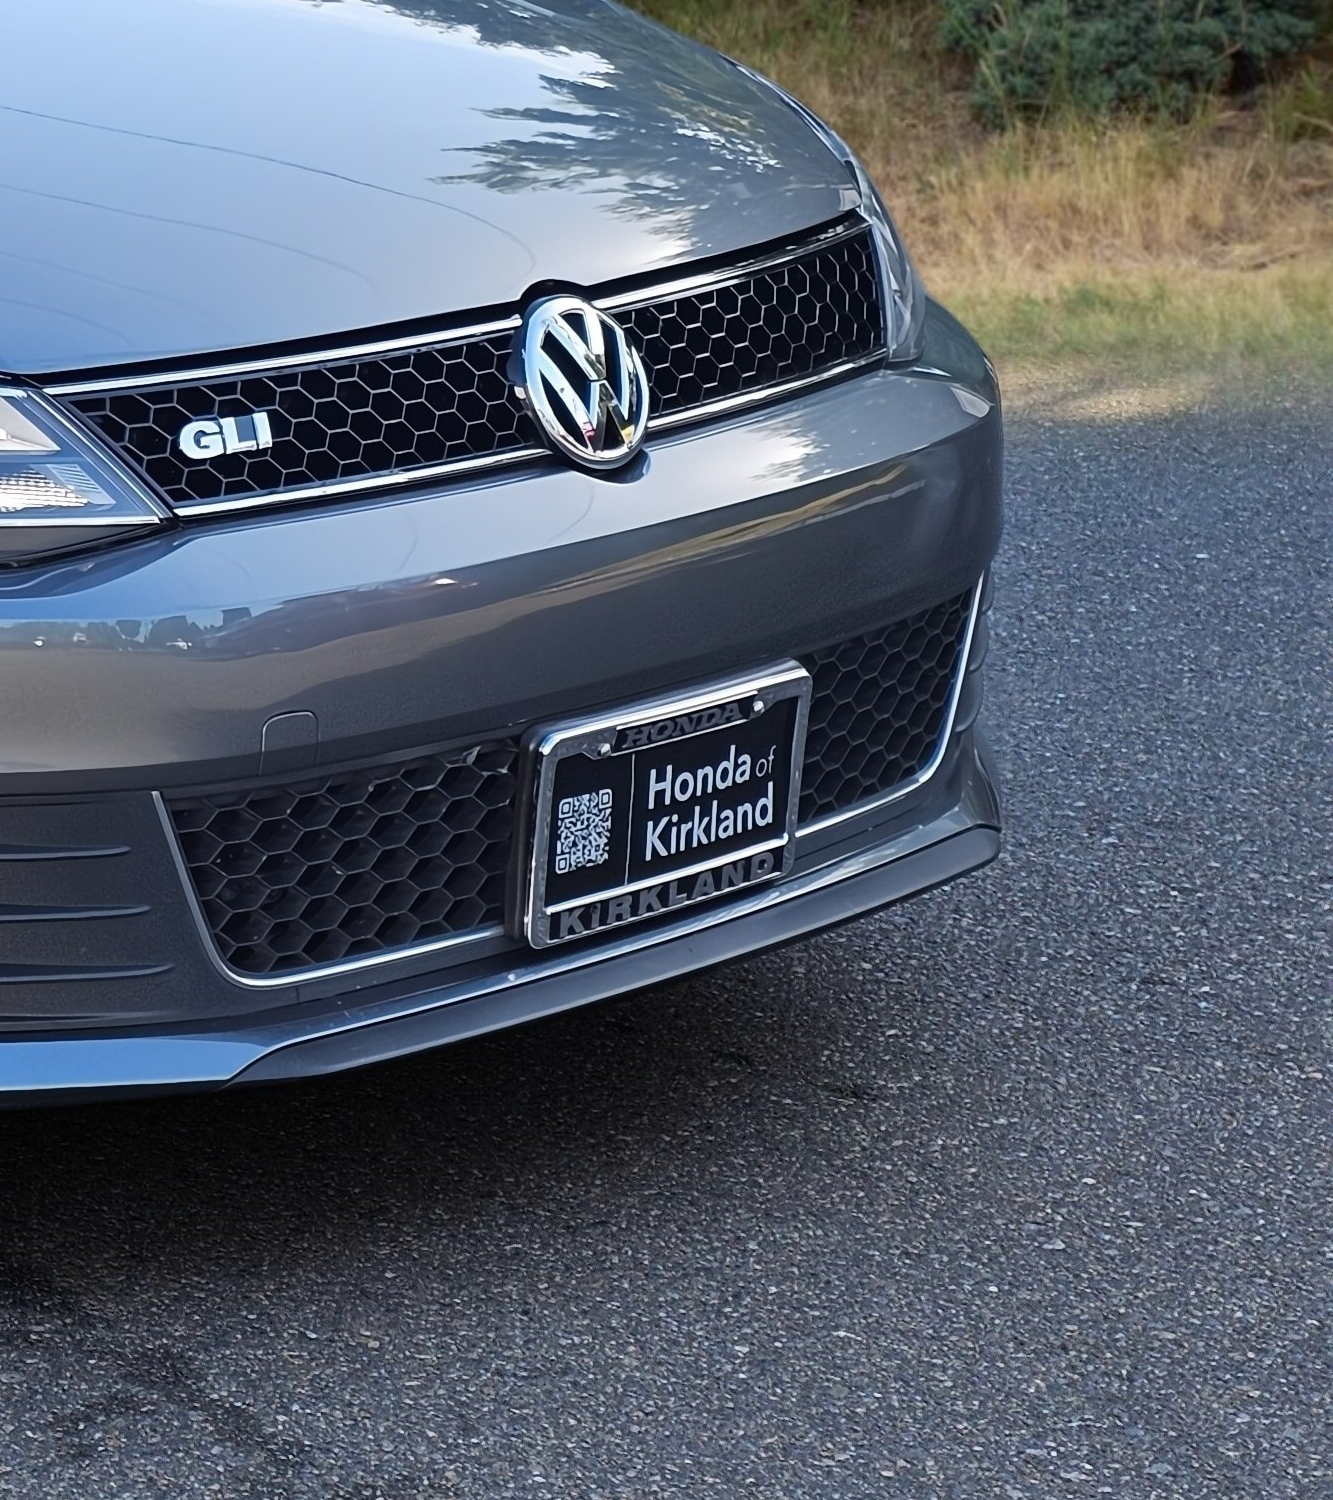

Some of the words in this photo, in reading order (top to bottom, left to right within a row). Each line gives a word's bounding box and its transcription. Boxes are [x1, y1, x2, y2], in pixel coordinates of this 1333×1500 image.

[178, 411, 273, 460] GLI
[622, 702, 744, 748] HONDA
[647, 744, 752, 810] Honda
[755, 745, 777, 777] of
[645, 781, 774, 862] Kirkland
[559, 851, 775, 938] KIRKLAND
